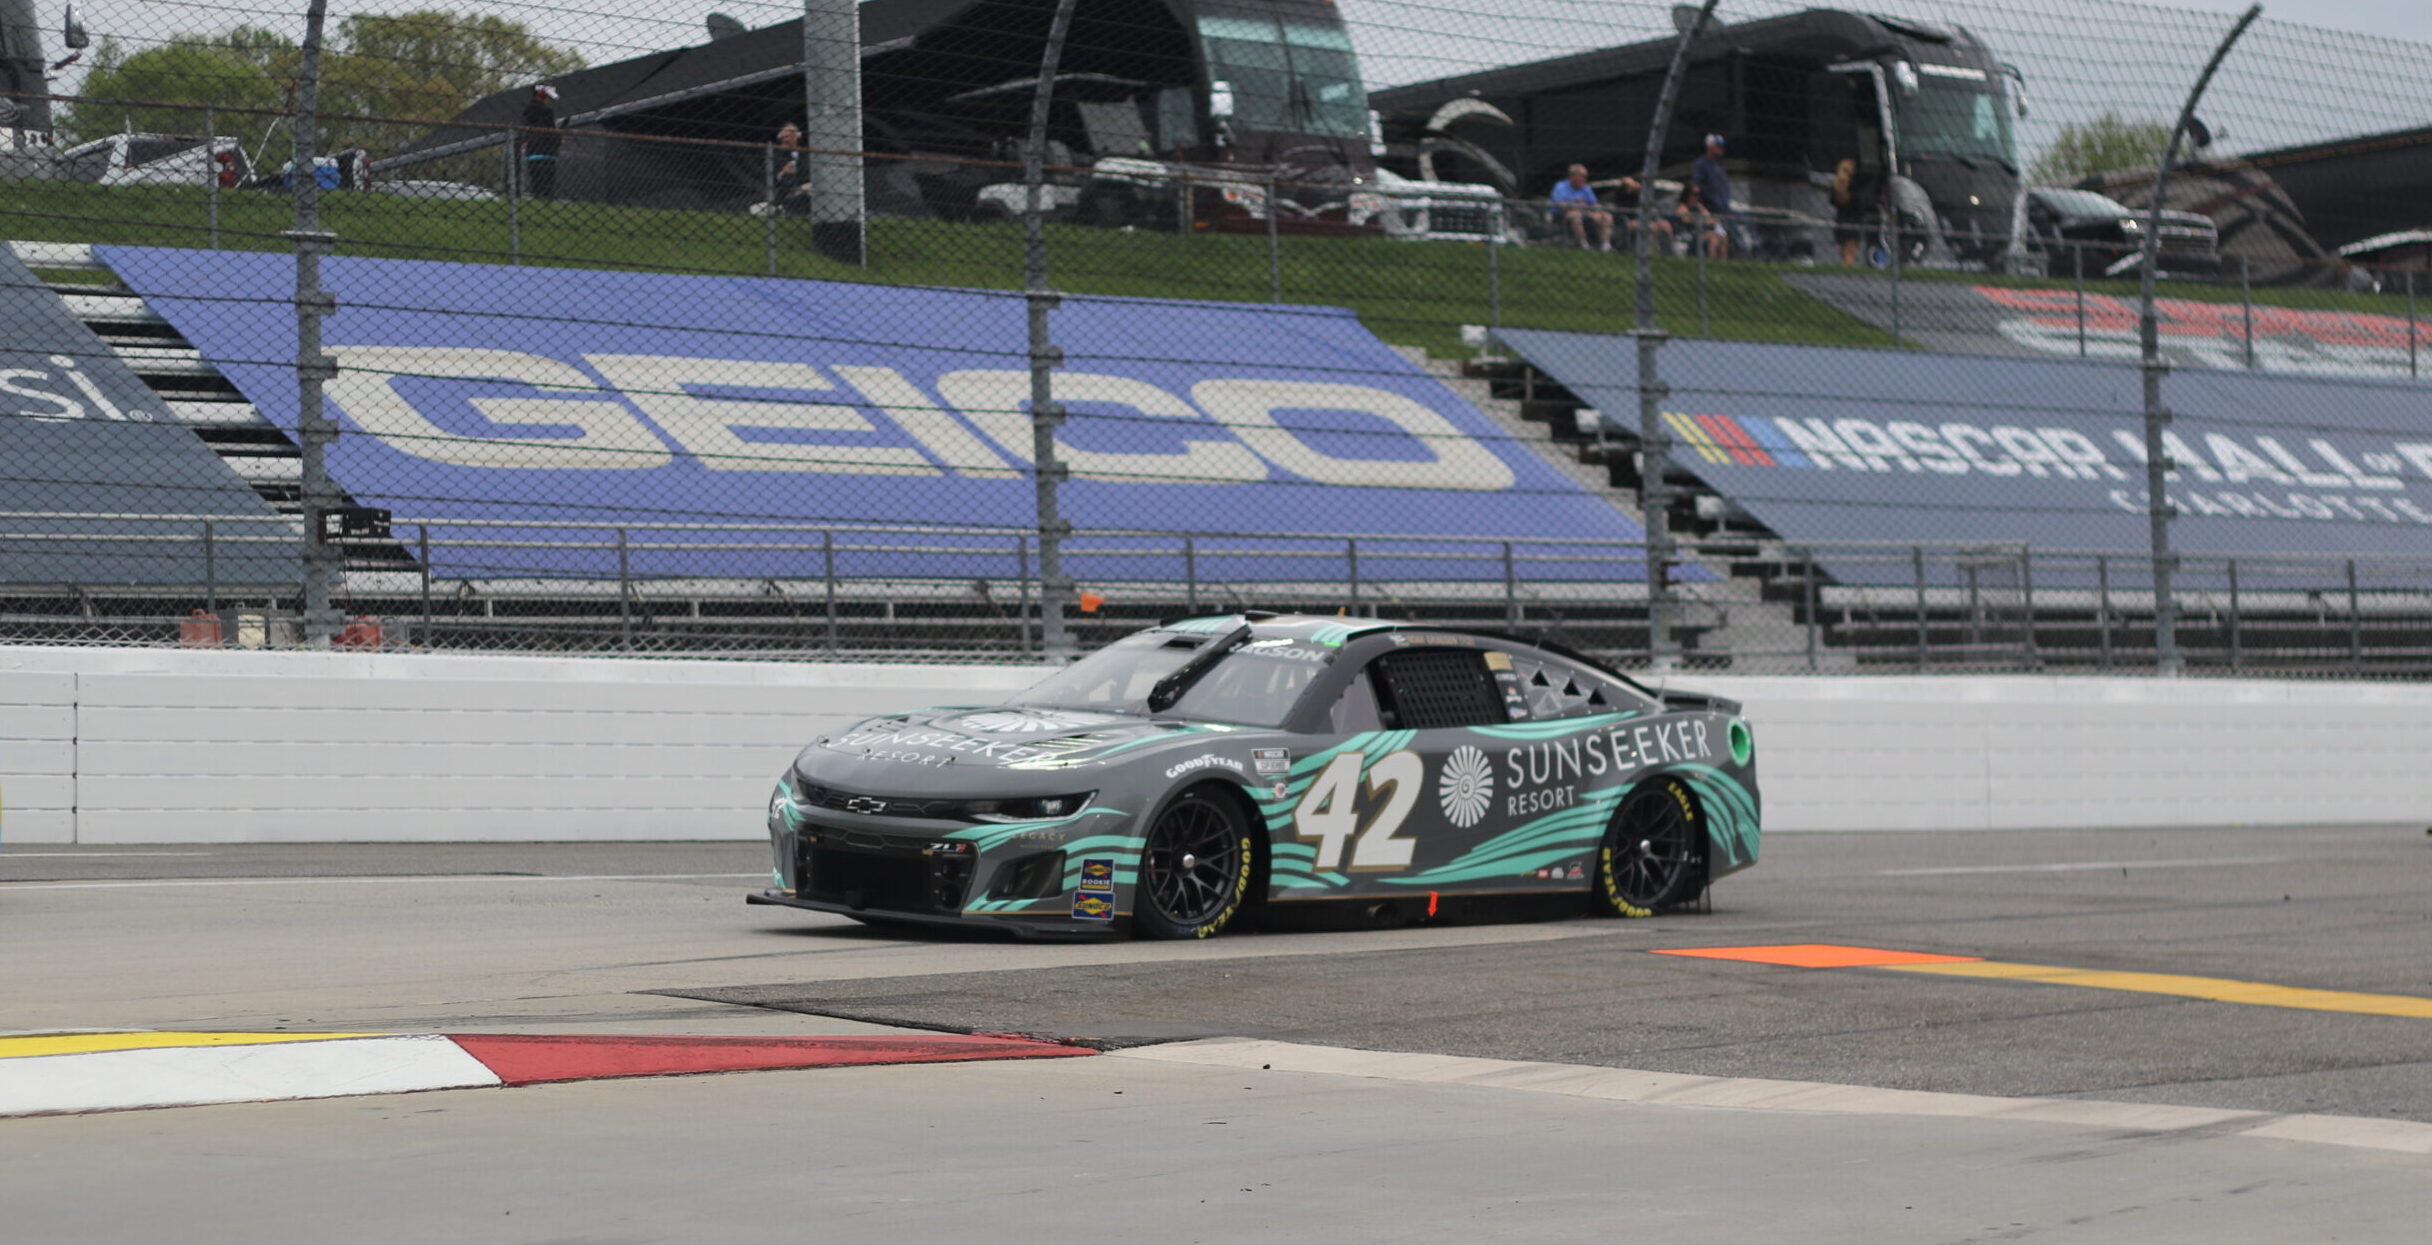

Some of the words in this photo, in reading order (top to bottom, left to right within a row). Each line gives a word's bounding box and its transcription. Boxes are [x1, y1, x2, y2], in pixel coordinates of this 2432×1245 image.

[320, 345, 1516, 490] GEICO
[1774, 416, 2130, 480] NASCAR
[2112, 430, 2405, 490] HALL
[1165, 754, 1244, 778] GOODYEAR
[1507, 719, 1712, 788] SUNSEEKER
[1294, 749, 1425, 873] 42
[1508, 785, 1575, 817] RESORT
[1667, 782, 1694, 821] EAGLE
